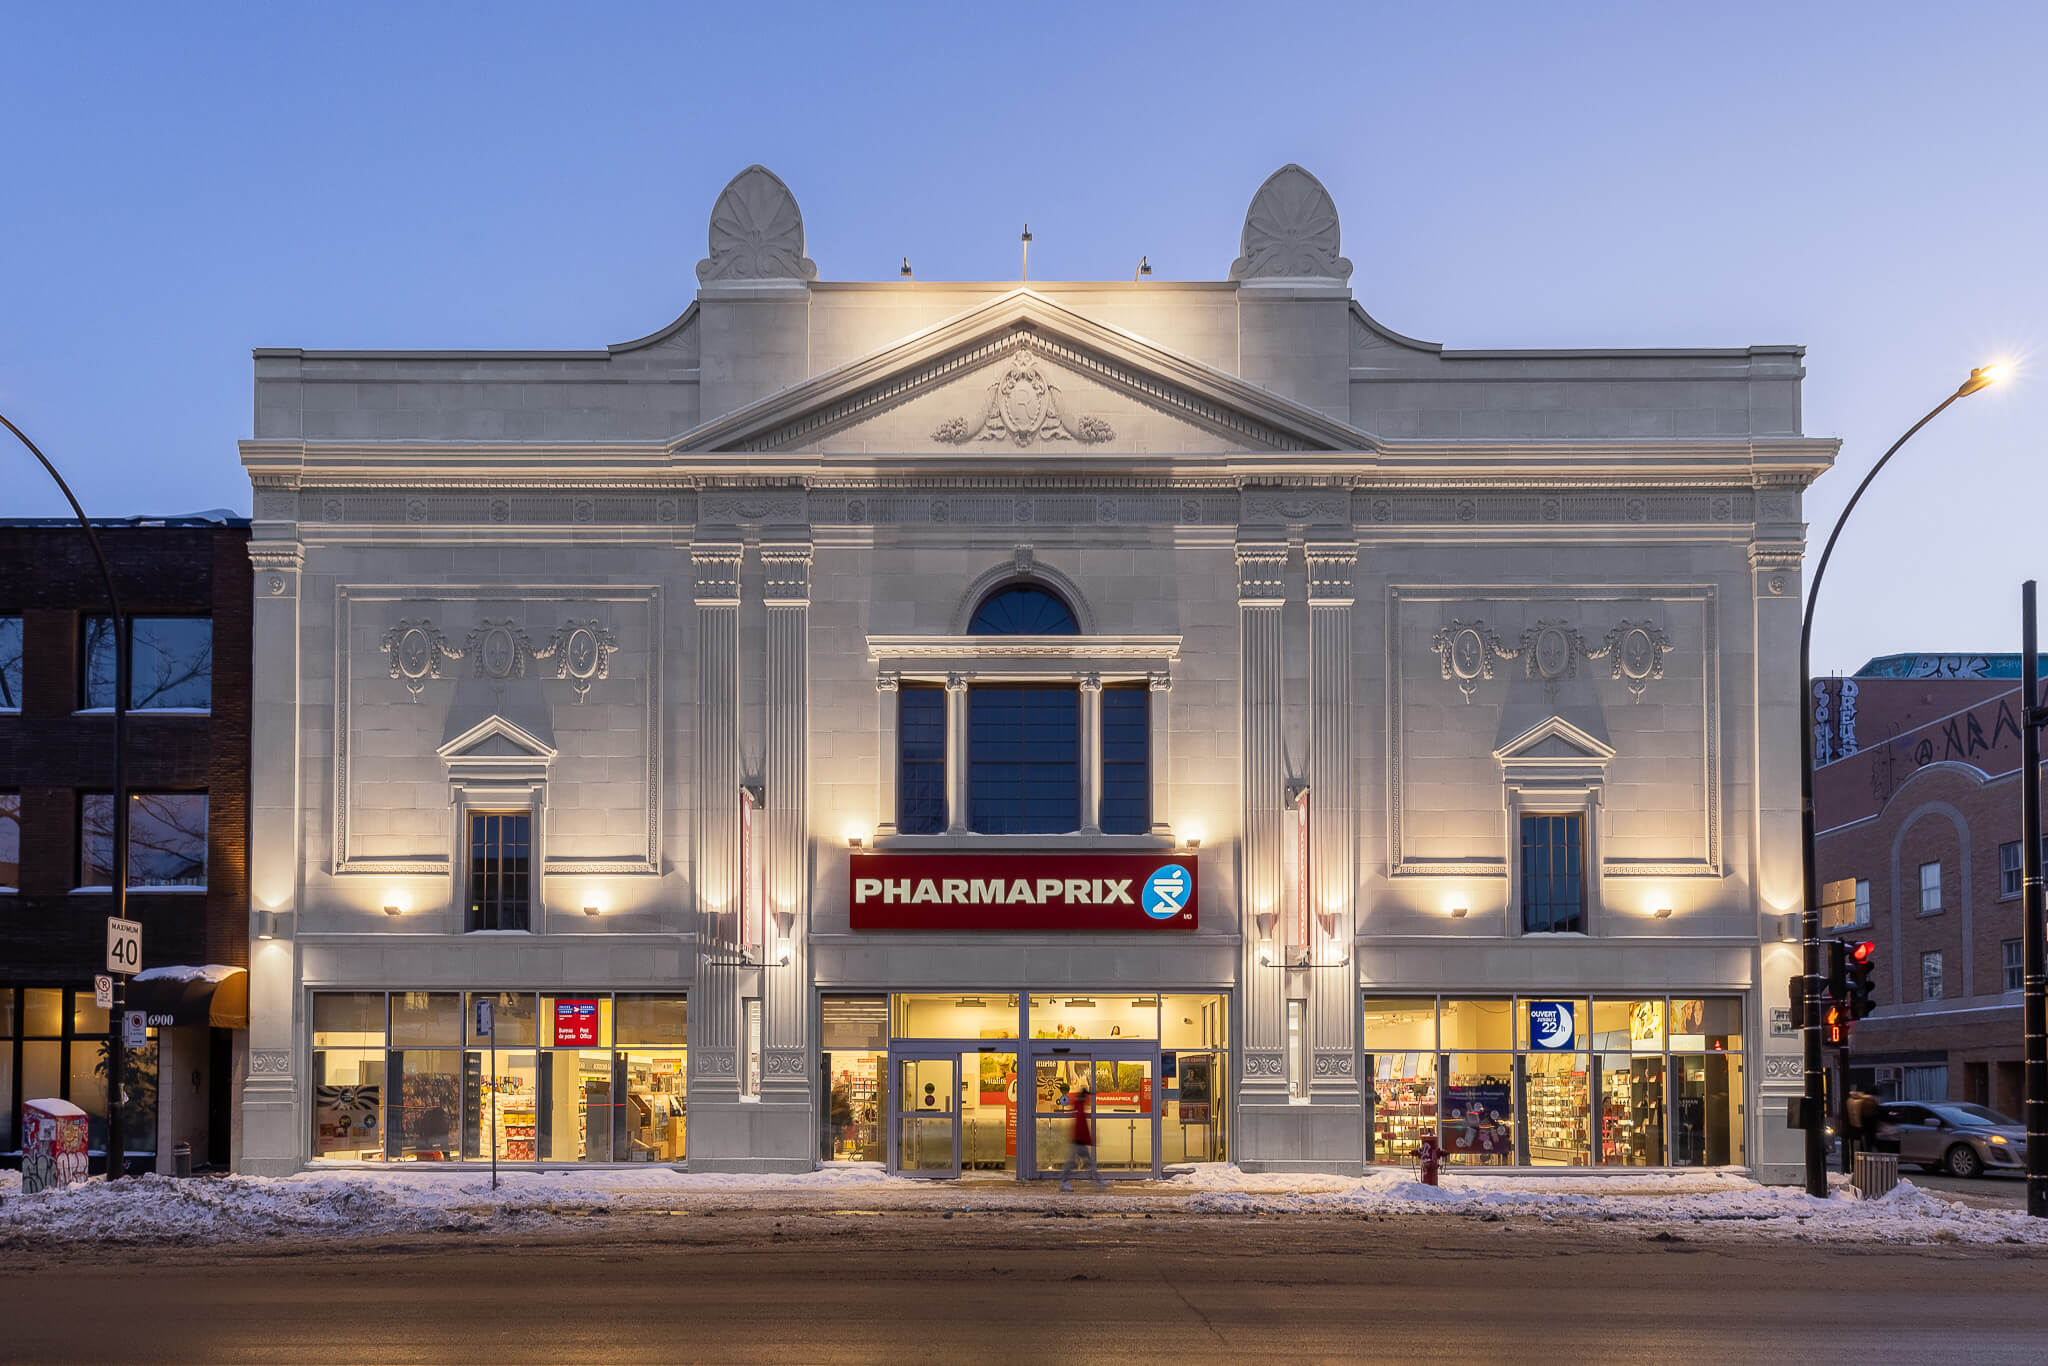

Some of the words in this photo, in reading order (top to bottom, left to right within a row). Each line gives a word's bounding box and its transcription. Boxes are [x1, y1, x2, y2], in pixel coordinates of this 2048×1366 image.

[855, 878, 1135, 904] PHARMAPRIX
[112, 923, 138, 933] MAXIMUM
[112, 938, 137, 965] 40
[148, 1015, 173, 1025] 6900
[1542, 1022, 1557, 1032] 22
